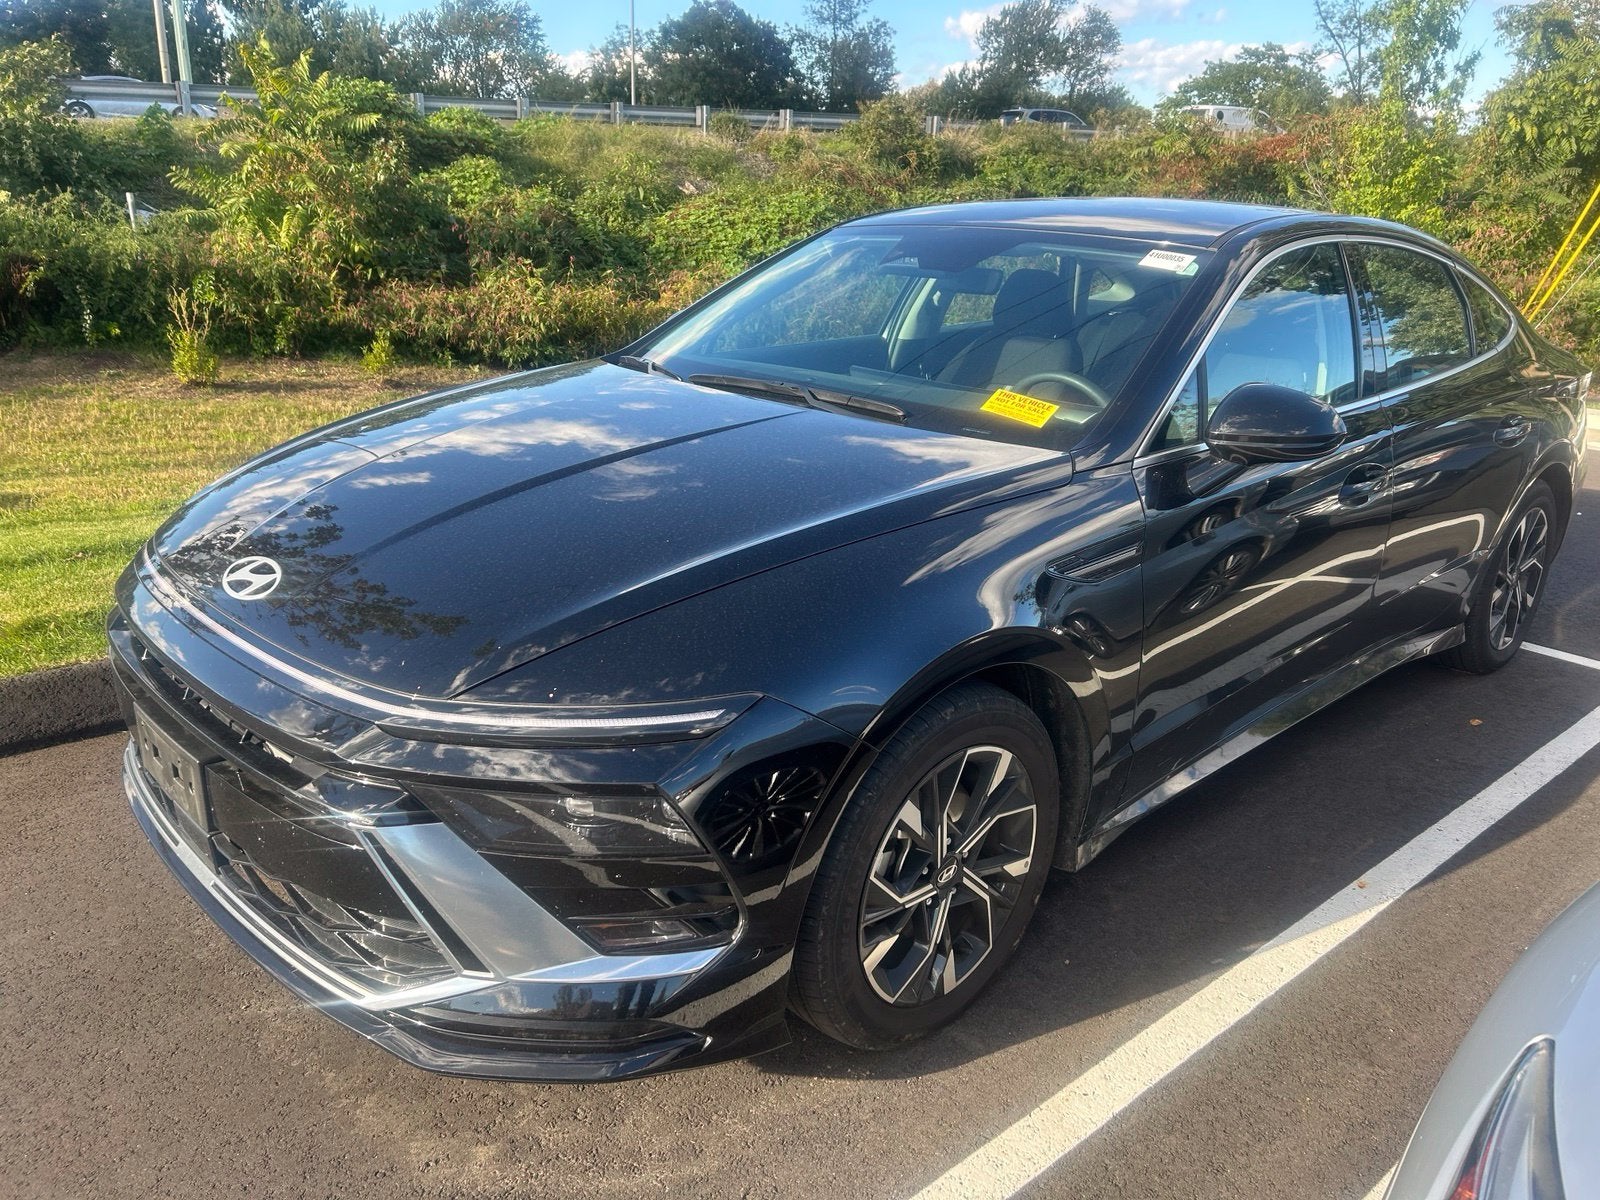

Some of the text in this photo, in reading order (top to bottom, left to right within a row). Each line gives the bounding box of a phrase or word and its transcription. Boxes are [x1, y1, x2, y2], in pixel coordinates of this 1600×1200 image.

[995, 397, 1010, 405] NOT
[1011, 401, 1025, 409] FOR
[1026, 406, 1046, 415] SALE
[998, 391, 1017, 400] THIS
[1018, 396, 1053, 411] VEHICLE
